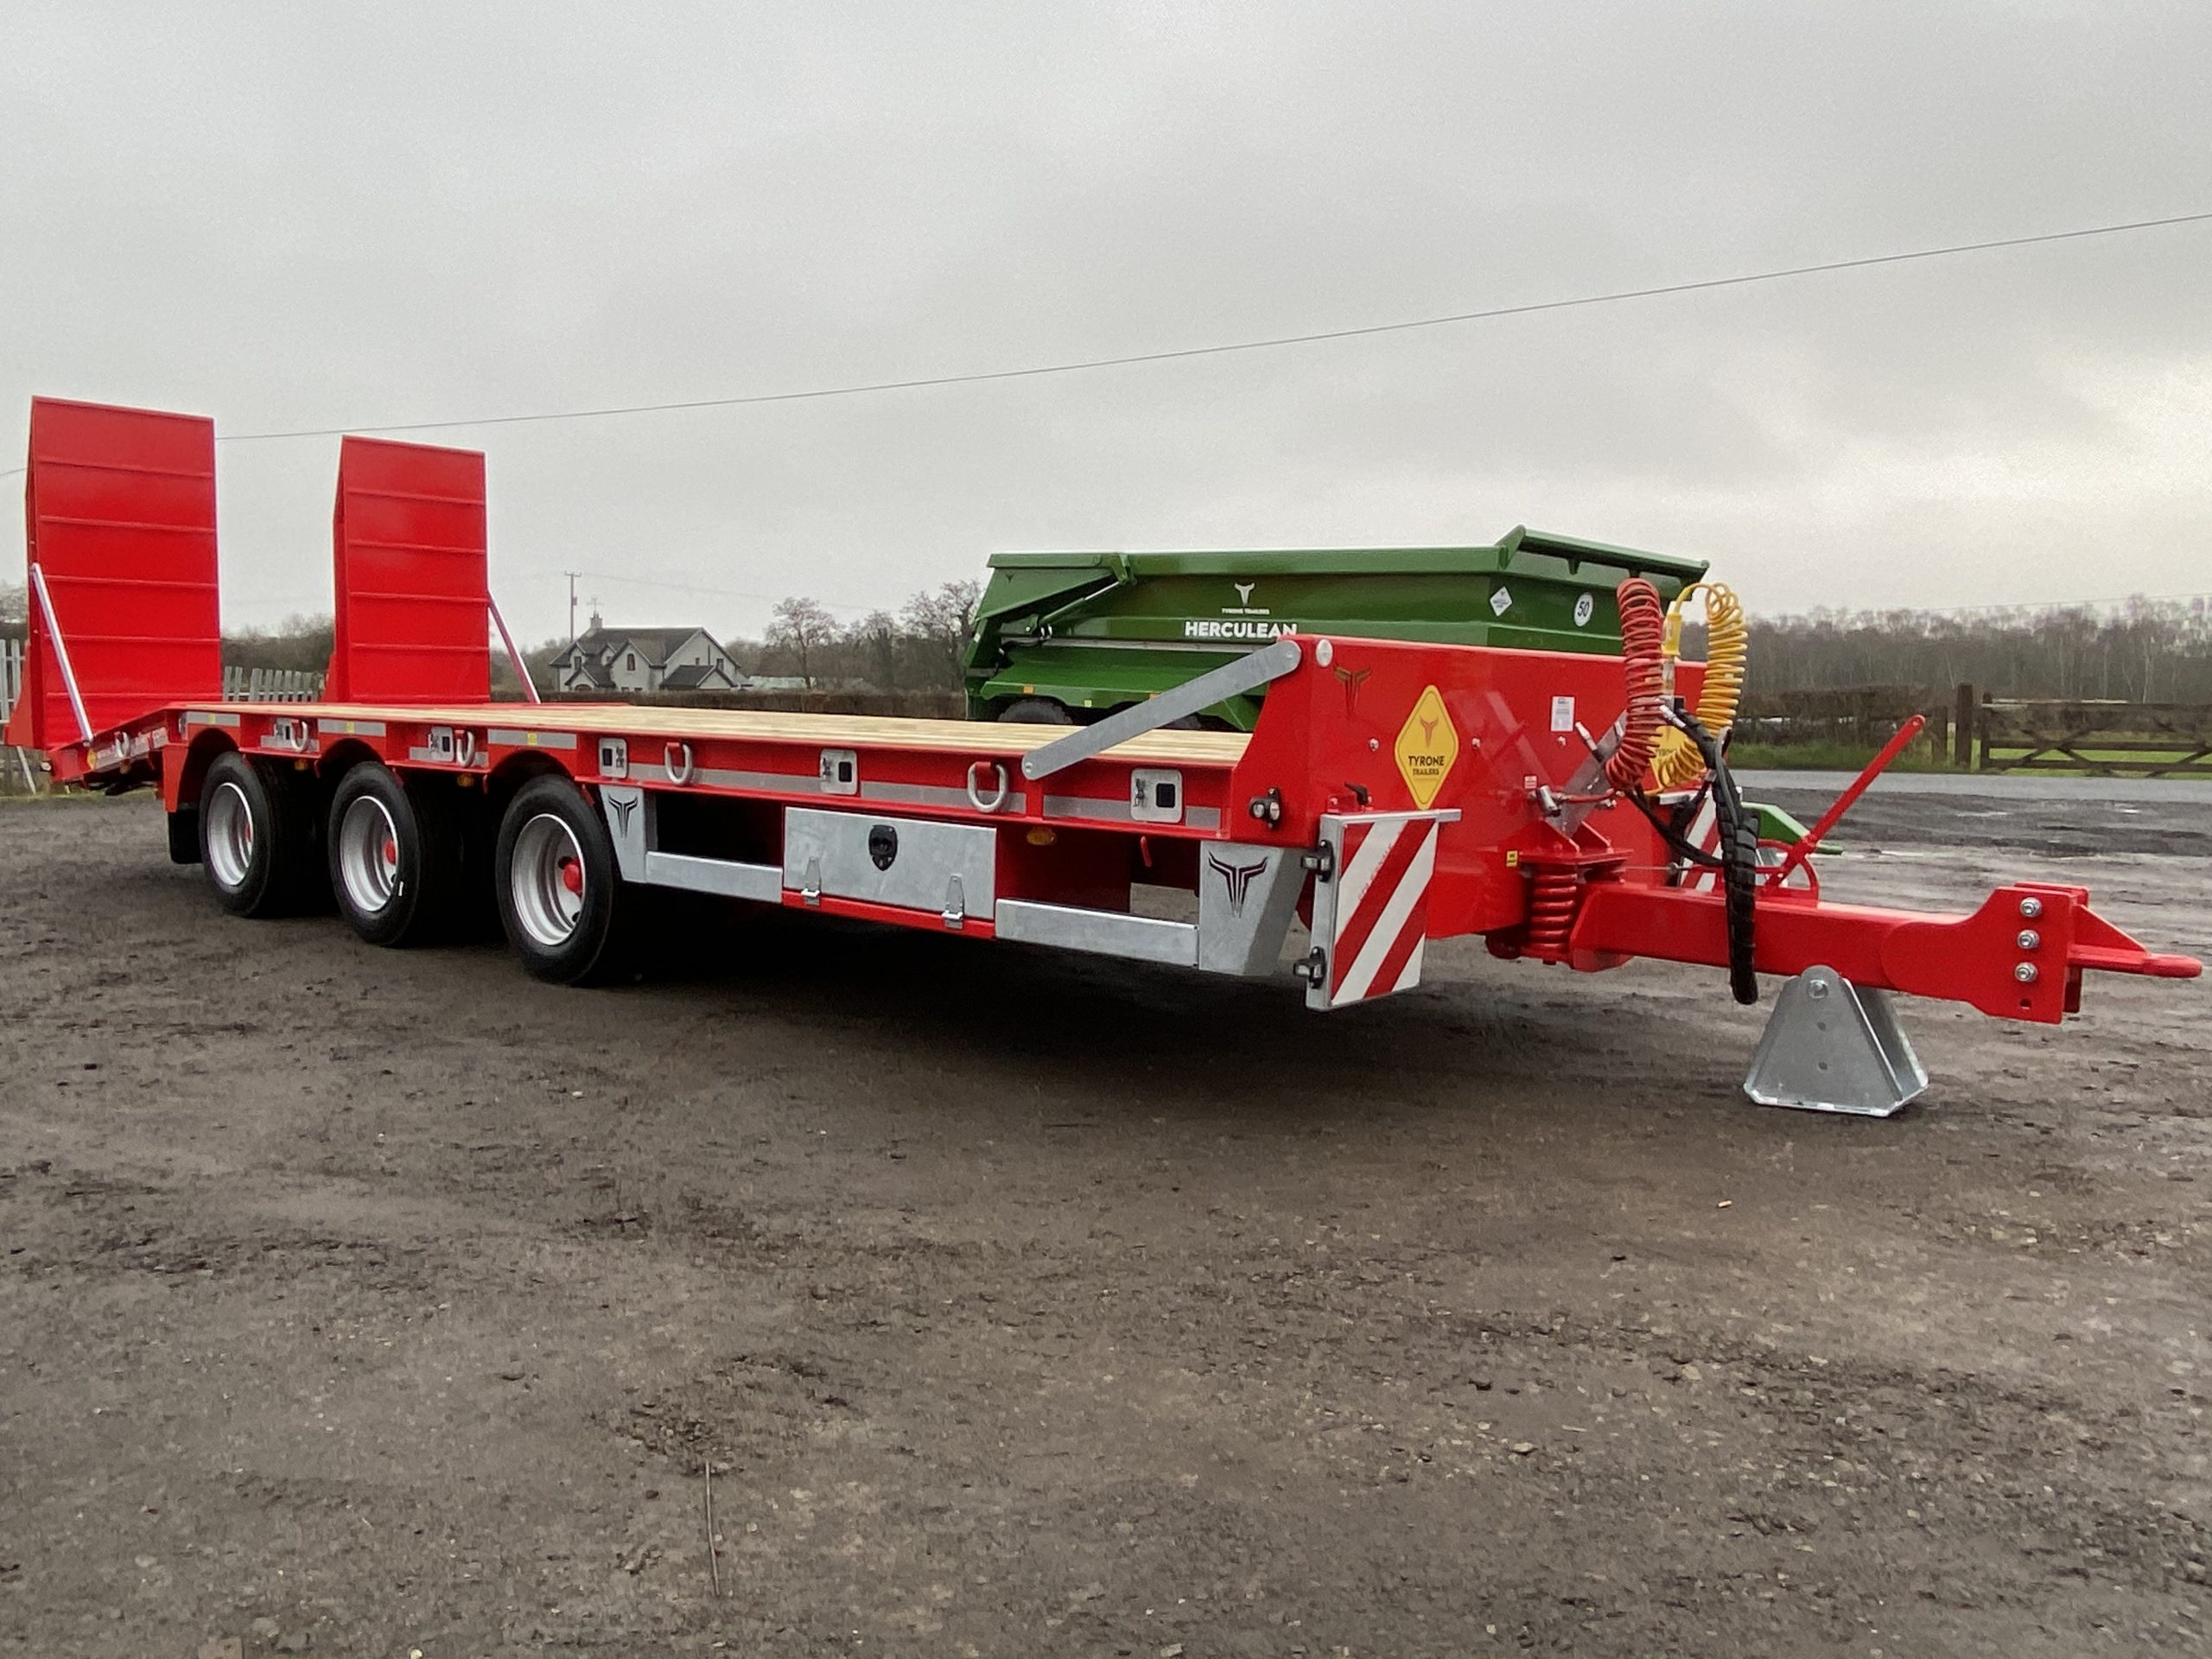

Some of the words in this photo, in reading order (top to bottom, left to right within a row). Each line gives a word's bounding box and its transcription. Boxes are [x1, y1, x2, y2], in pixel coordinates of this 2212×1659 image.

[1577, 601, 1590, 617] 50
[1185, 621, 1298, 638] HERCULEAN
[1408, 755, 1445, 767] TYRONE
